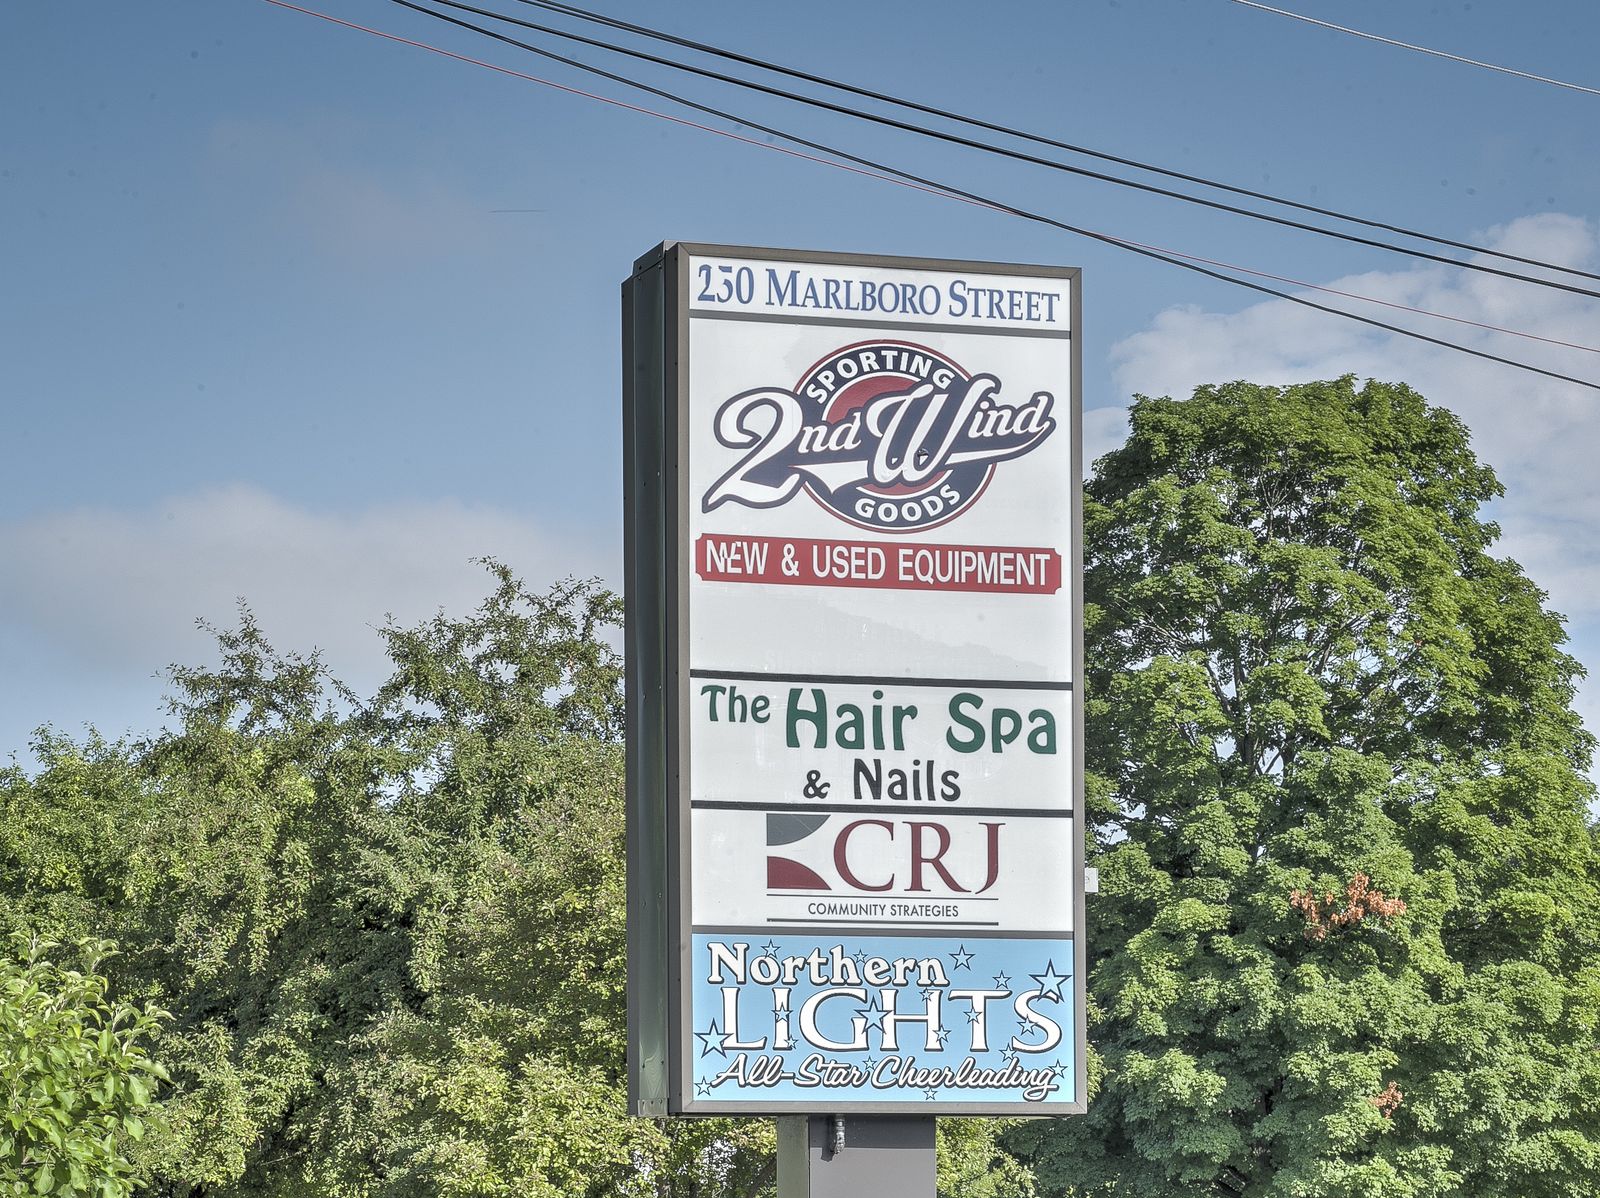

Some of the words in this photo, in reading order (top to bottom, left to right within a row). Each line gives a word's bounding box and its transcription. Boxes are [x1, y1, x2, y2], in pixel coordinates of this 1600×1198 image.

[697, 264, 755, 304] 250
[765, 268, 941, 315] MARLBORO
[949, 280, 1060, 323] STREET
[806, 350, 956, 403] SPORTING
[702, 387, 867, 513] 2nd
[866, 373, 1056, 487] Wind
[854, 483, 960, 522] GOODS
[706, 539, 769, 575] NEW
[781, 543, 800, 577] &
[812, 544, 886, 580] USED
[898, 548, 1050, 586] EQUIPMENT
[700, 685, 770, 724] The
[786, 688, 918, 751] Hair
[946, 692, 1057, 754] Spa
[802, 769, 831, 800] &
[853, 758, 961, 801] Nails
[833, 819, 1006, 895] CRJ
[808, 902, 886, 917] COMMUNITY
[890, 903, 959, 918] STRATEGIES
[707, 941, 950, 986] Northern
[720, 986, 1063, 1053] LIGHTS
[714, 1053, 871, 1089] All-Star
[871, 1055, 1060, 1101] Cheerleading
